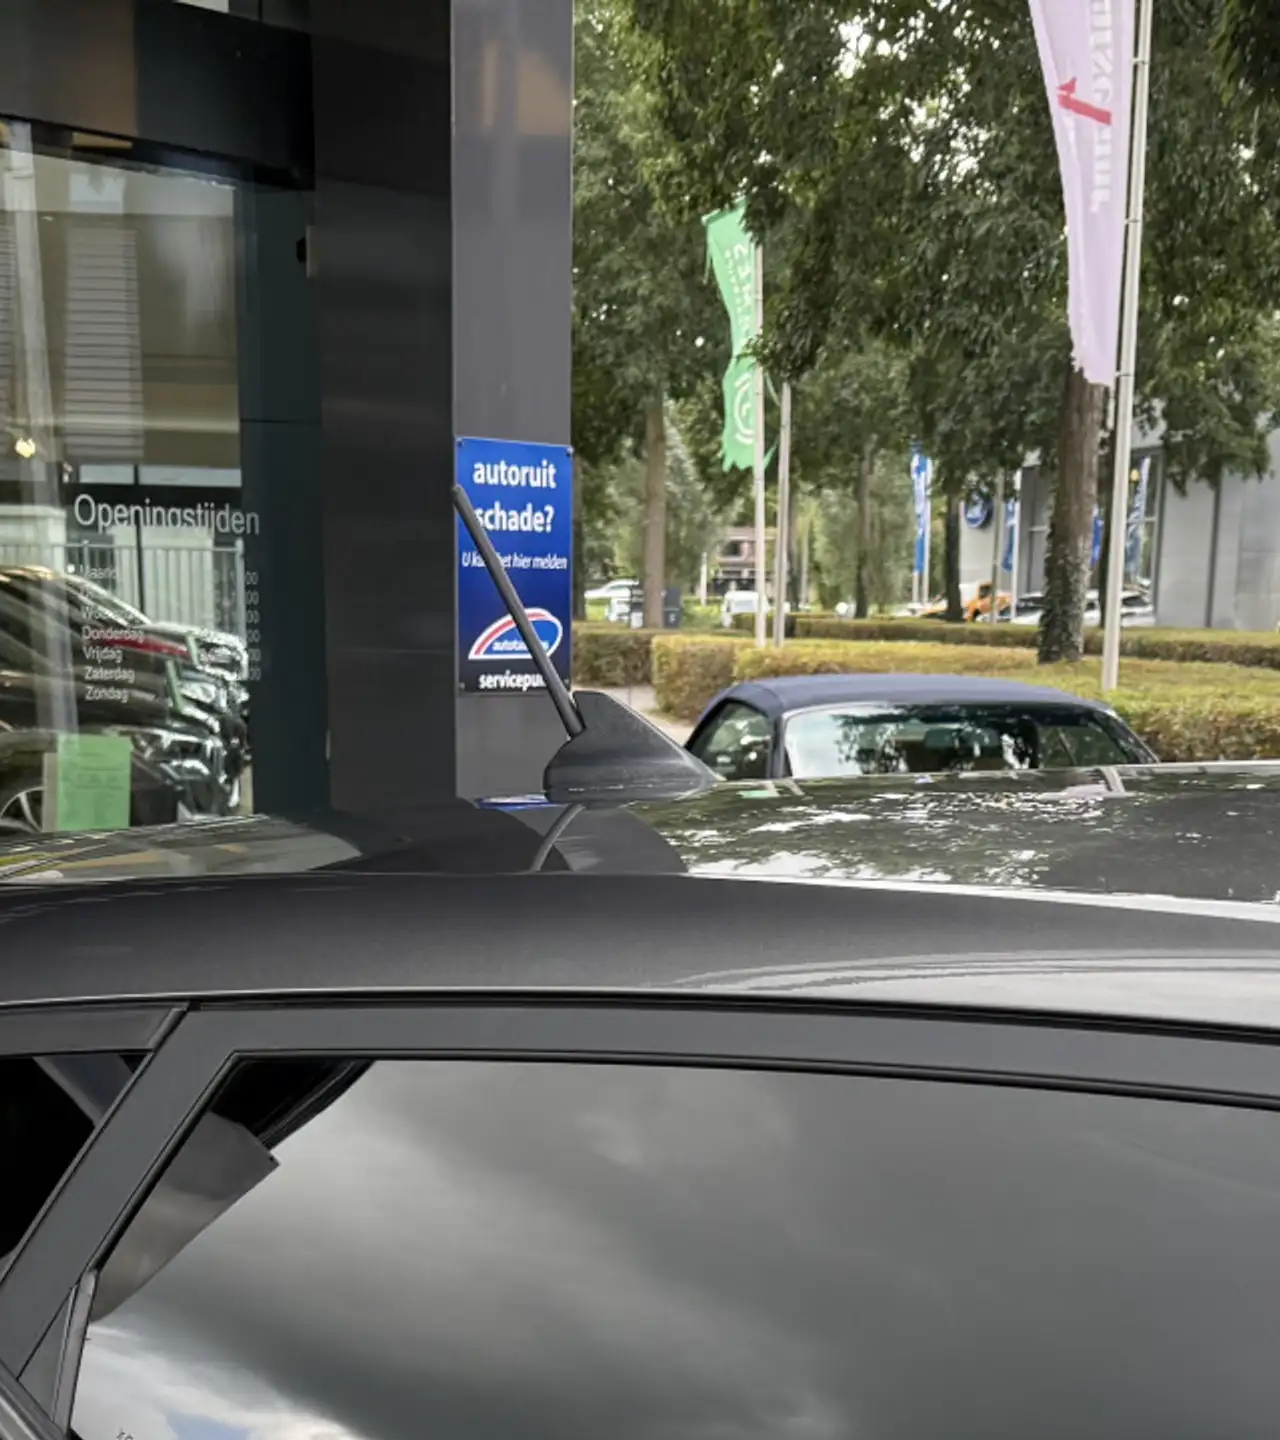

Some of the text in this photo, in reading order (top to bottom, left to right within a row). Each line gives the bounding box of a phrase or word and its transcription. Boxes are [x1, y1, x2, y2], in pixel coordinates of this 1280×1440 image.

[473, 459, 557, 489] autoruit
[74, 493, 261, 536] Openingstijden
[476, 501, 554, 533] schade?
[512, 551, 532, 568] hier
[532, 552, 568, 570] melden
[84, 666, 135, 683] Zaterdag
[85, 686, 129, 703] Zondag
